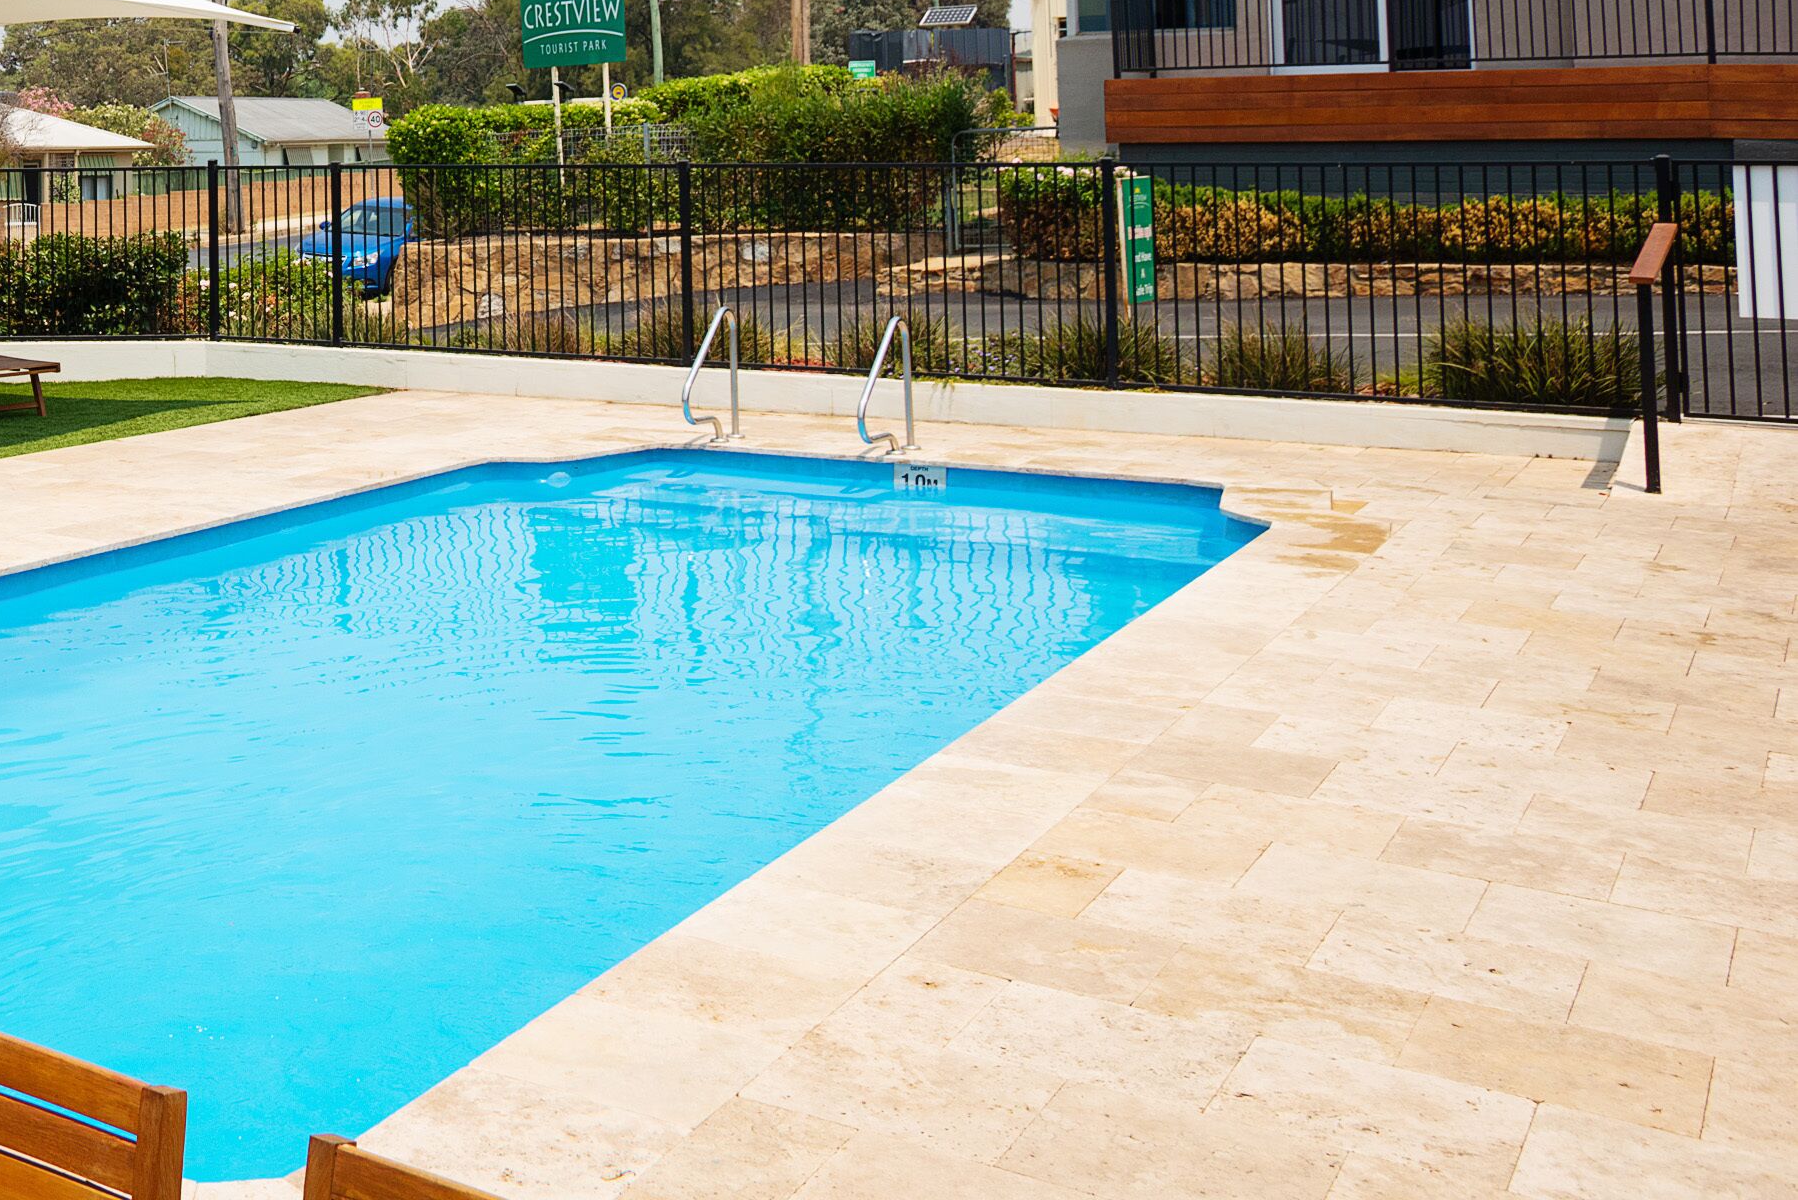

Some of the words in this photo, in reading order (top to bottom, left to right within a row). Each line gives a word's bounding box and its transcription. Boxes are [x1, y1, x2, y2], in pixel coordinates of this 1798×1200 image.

[540, 41, 578, 55] TOURIST
[582, 39, 607, 52] PARK
[370, 115, 381, 123] 40
